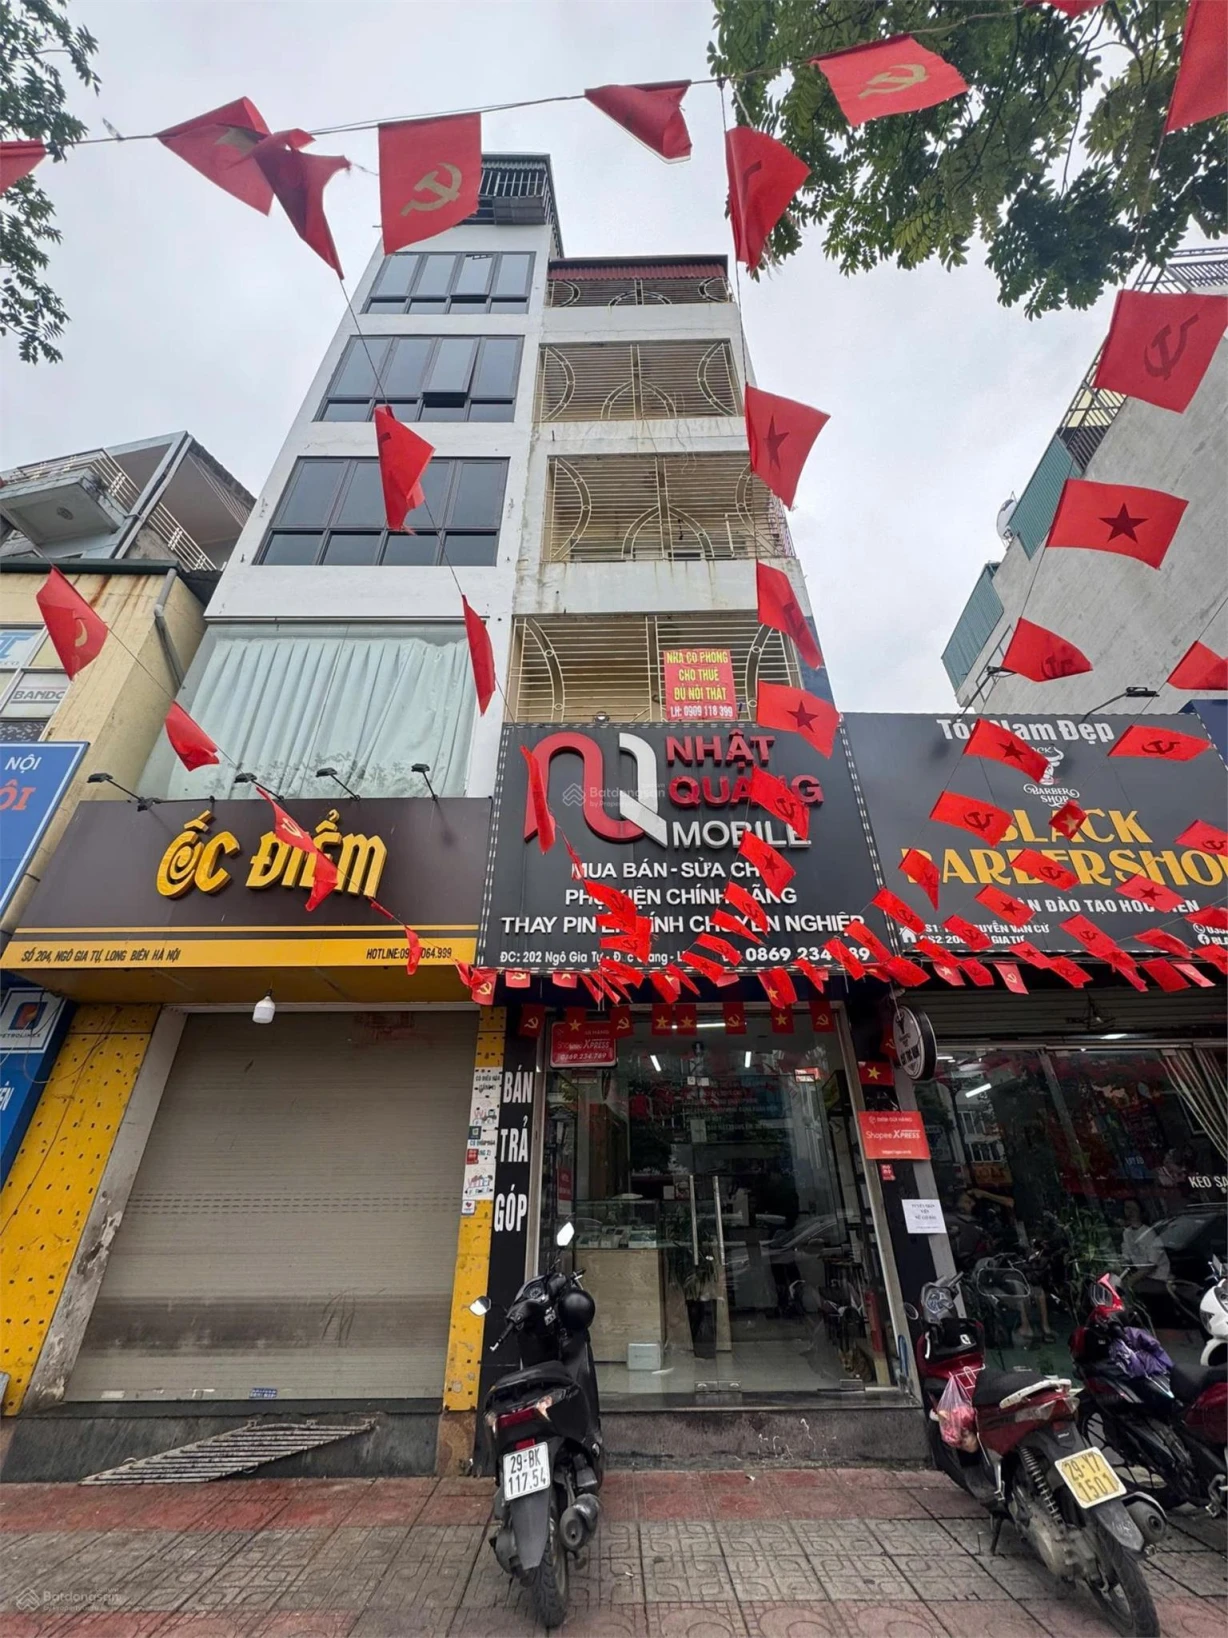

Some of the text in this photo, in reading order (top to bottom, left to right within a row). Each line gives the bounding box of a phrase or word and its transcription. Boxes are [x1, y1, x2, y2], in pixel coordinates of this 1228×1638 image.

[678, 669, 696, 681] CHO
[670, 706, 682, 718] LH:
[704, 705, 718, 717] 118
[719, 705, 733, 717] 399
[936, 718, 975, 740] Tó
[1056, 719, 1115, 745] Đẹp
[666, 729, 775, 771] NHẬT
[5, 754, 42, 774] NỘI
[669, 775, 824, 808] QUAG
[1026, 785, 1075, 797] BARBER
[572, 862, 617, 878] MUA
[623, 858, 668, 878] BÁN
[681, 857, 726, 878] SỬA
[730, 862, 760, 878] CH
[666, 884, 730, 904] CHÍNH
[744, 884, 798, 904] ÃNG
[1045, 896, 1081, 912] ĐÀO
[1084, 899, 1117, 915] TẠO
[501, 916, 558, 933] THAY
[563, 916, 597, 933] PIN
[648, 911, 684, 933] ÍNH
[21, 947, 36, 962] SỐ
[35, 950, 51, 965] 204,
[54, 948, 72, 962] NGÔ
[74, 950, 88, 962] GIA
[104, 950, 127, 962] LONG
[130, 948, 150, 962] BIÊN
[152, 948, 164, 961] HÀ
[166, 948, 182, 962] NỘI
[500, 951, 520, 963] ĐC:
[522, 951, 541, 963] 202
[545, 951, 567, 966] Ngô
[569, 951, 588, 963] Gia
[613, 951, 634, 963] Đc
[745, 947, 791, 962] 0869
[797, 947, 832, 962] 234
[503, 1064, 533, 1103] BÁN
[500, 1115, 528, 1162] TRẢ
[865, 1129, 921, 1140] Shopee XPRESS
[493, 1183, 528, 1232] GÓP
[510, 1447, 541, 1474] 29-BK
[508, 1466, 546, 1495] 117.54
[1077, 1473, 1117, 1501] 1501
